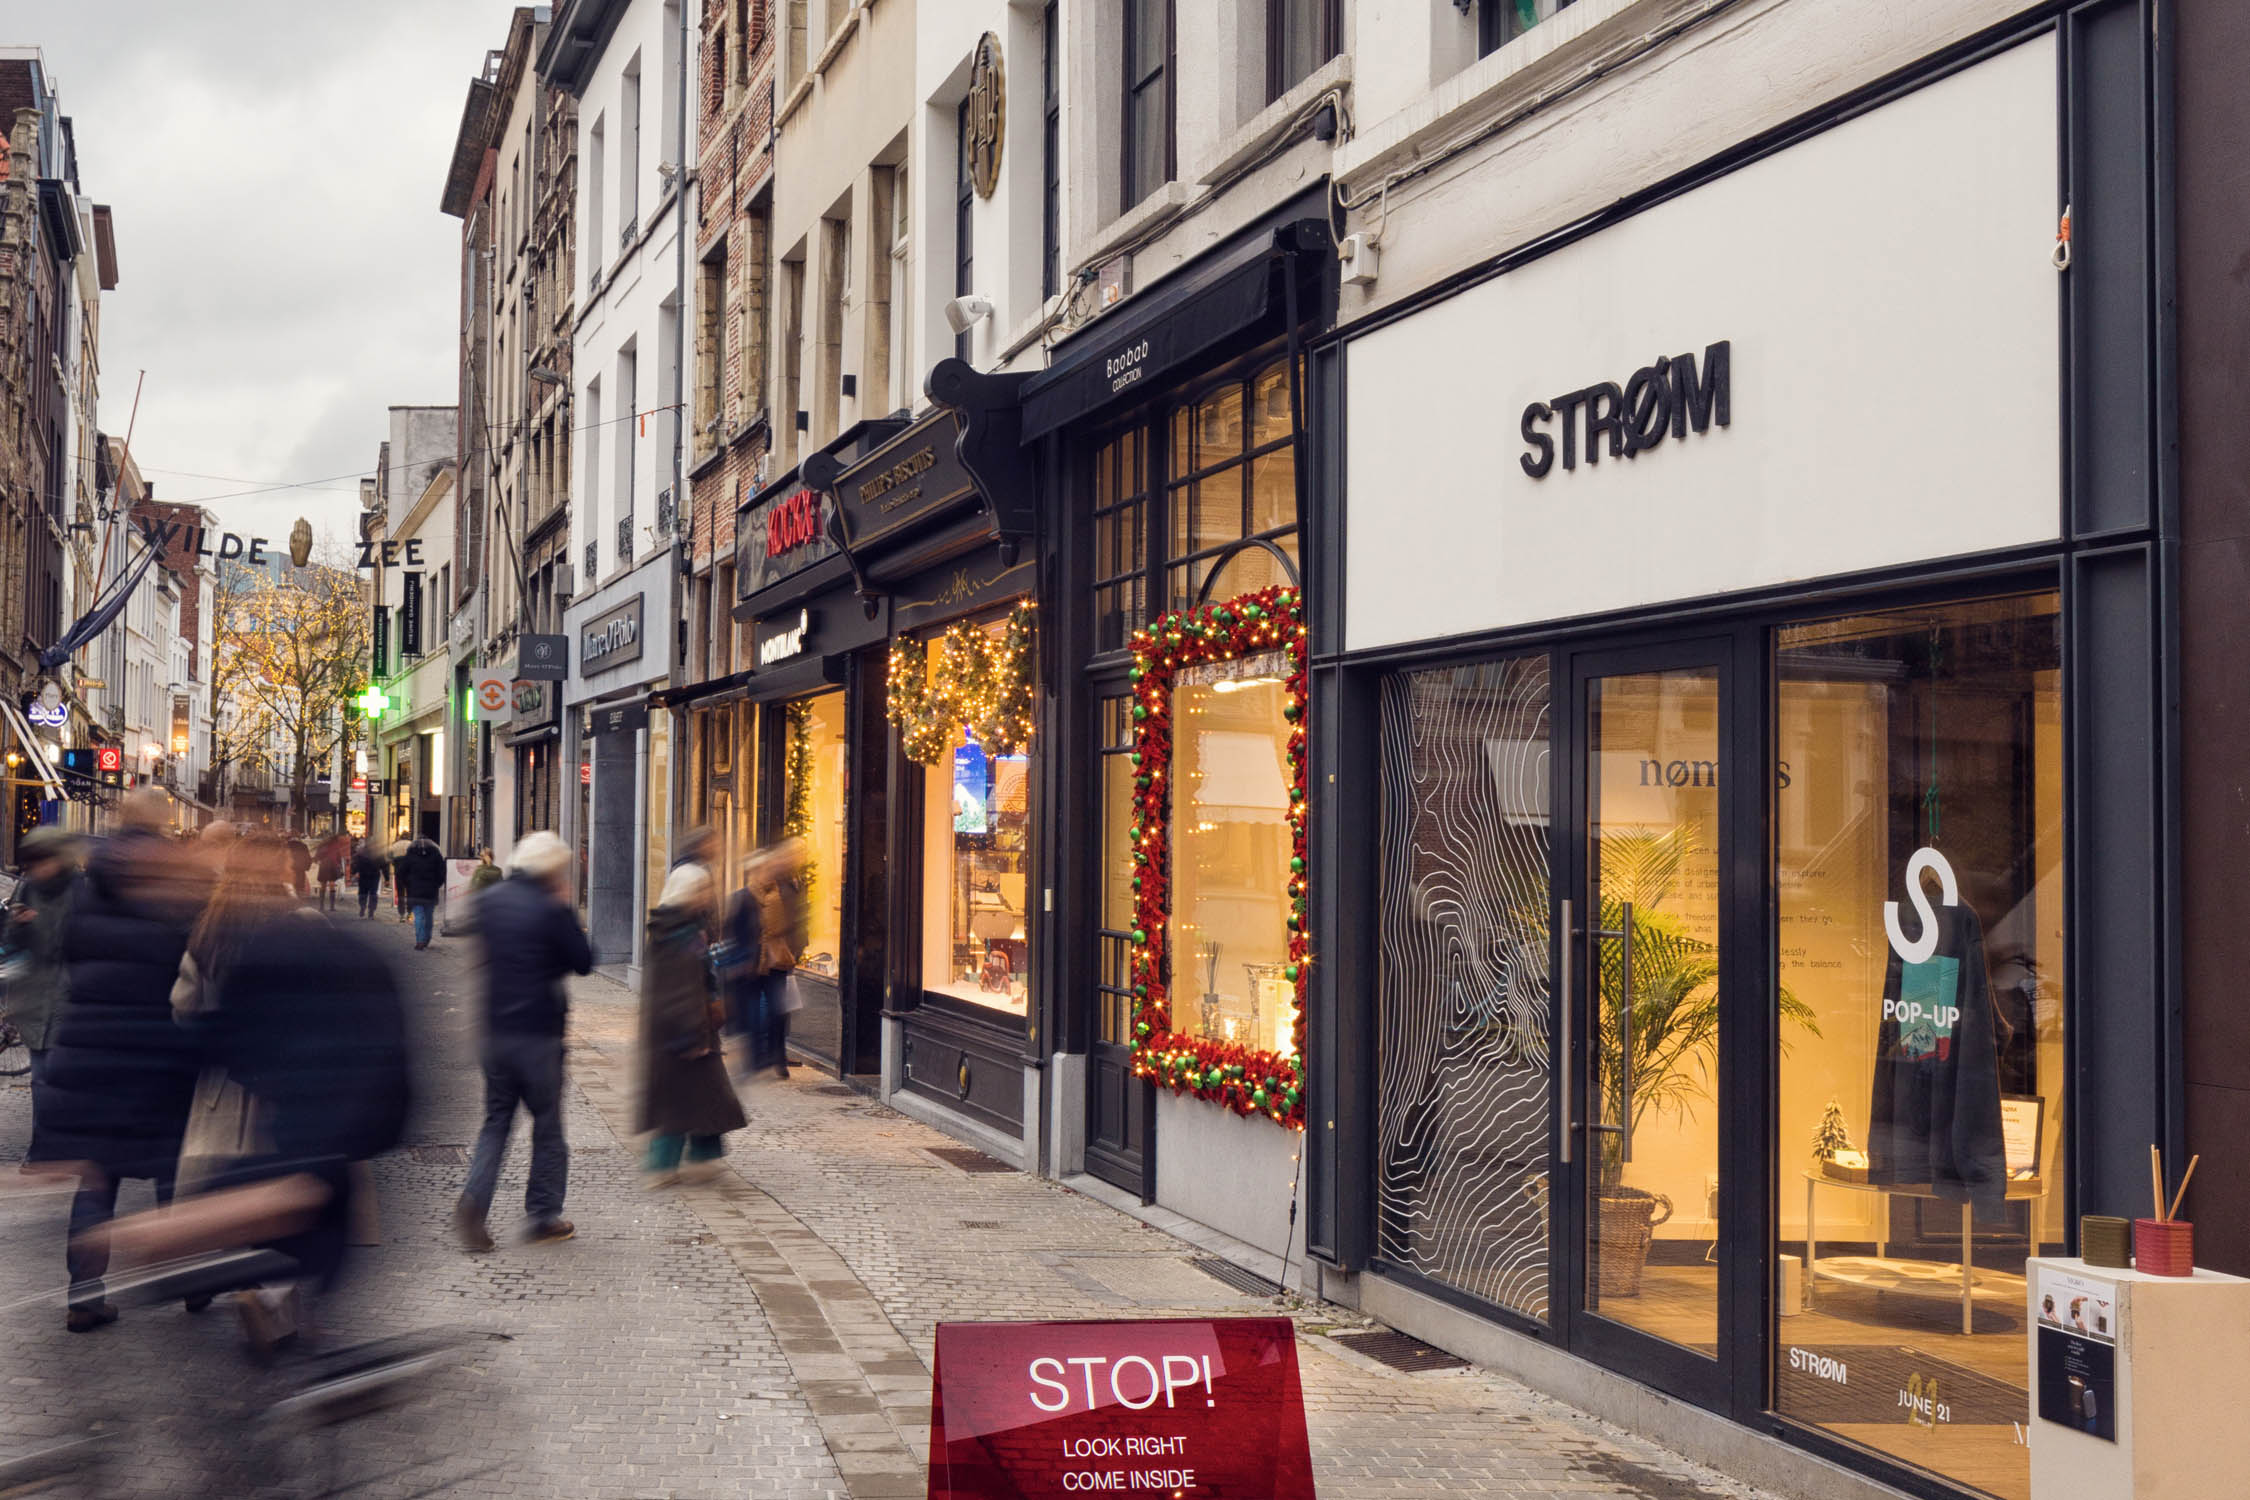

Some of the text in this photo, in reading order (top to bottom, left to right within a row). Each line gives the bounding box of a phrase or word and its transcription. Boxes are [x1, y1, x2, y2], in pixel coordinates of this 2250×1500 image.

[1106, 339, 1149, 379] Baobab
[1112, 366, 1142, 393] COLLECTION
[1519, 340, 1731, 478] STRØM
[142, 514, 268, 566] WILDE
[355, 538, 425, 568] ZEE
[1884, 1000, 1960, 1029] POP-UP
[1029, 1354, 1215, 1412] STOP!
[1789, 1347, 1847, 1385] STRØM
[1897, 1389, 1951, 1422] JUNE 21
[1063, 1436, 1187, 1457] LOOK RIGHT
[1062, 1469, 1197, 1491] COME INSIDE
